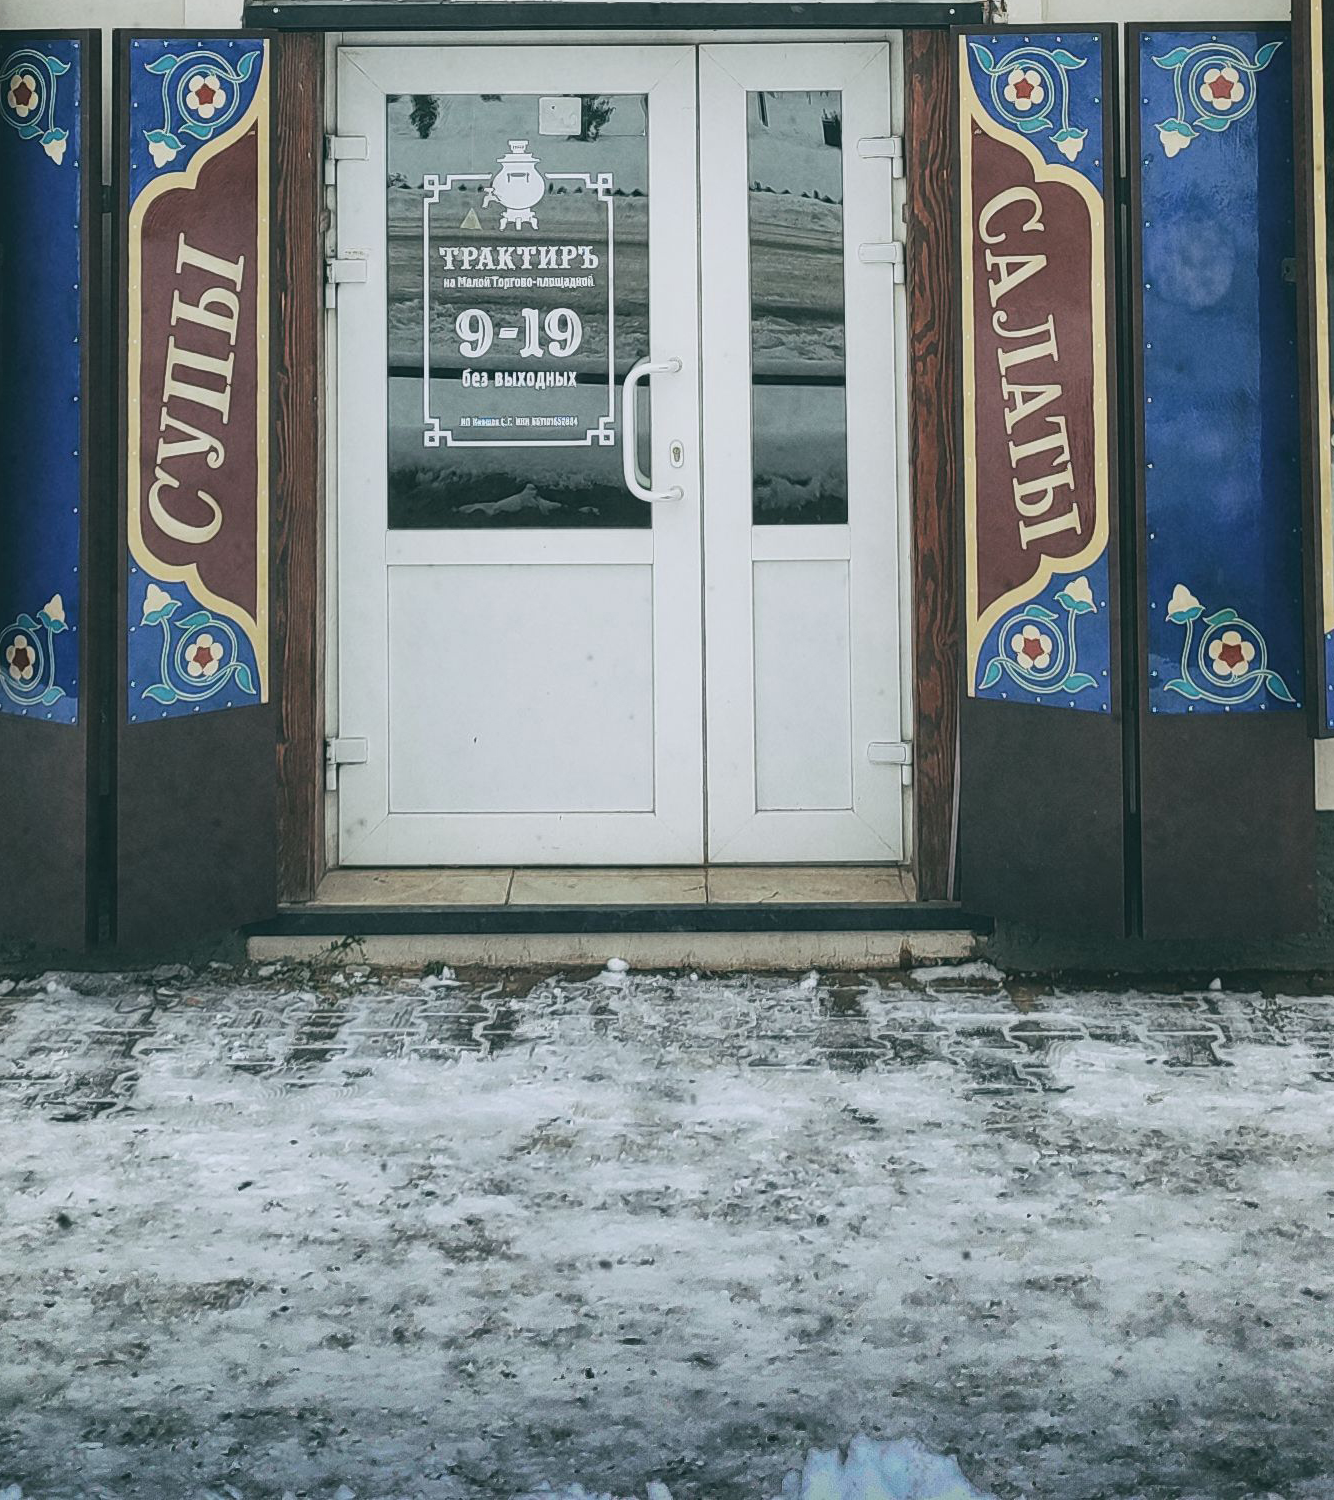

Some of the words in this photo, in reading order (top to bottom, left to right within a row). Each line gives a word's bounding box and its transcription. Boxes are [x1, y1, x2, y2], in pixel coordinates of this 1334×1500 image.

[438, 245, 599, 270] ТРАКТИРЪ
[443, 277, 456, 288] на
[457, 276, 492, 288] Малой
[455, 306, 583, 359] 9-19
[462, 367, 489, 388] без
[494, 370, 578, 390] выходных
[978, 185, 1082, 551] САЛАТЫ
[148, 231, 245, 545] СУПЫ
